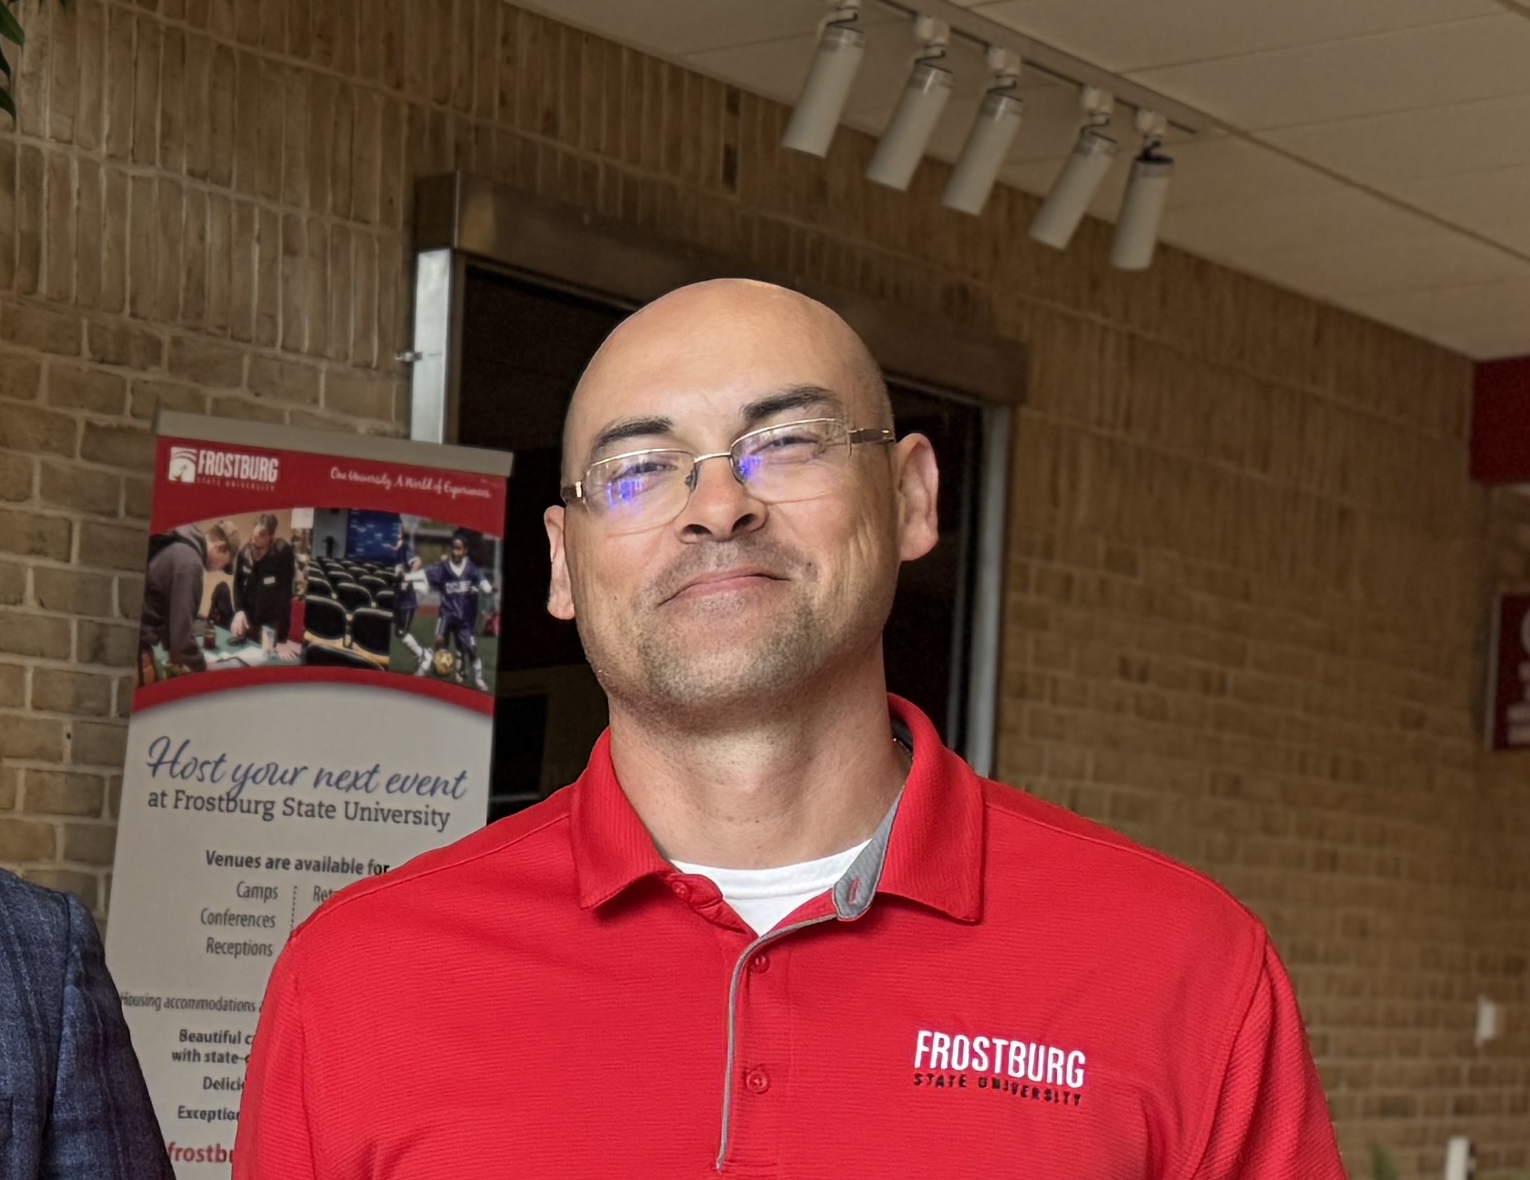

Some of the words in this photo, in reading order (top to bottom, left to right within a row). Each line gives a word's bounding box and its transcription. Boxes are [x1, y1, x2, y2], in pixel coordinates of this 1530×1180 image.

[197, 450, 279, 483] FROSTBURG
[146, 735, 228, 784] Host
[230, 761, 308, 800] your
[313, 763, 380, 794] next
[385, 769, 467, 800] event
[147, 788, 167, 809] at
[172, 789, 276, 822] Frostburg
[282, 797, 337, 820] State
[343, 799, 451, 833] University
[205, 850, 261, 869] Venues
[265, 857, 291, 871] are
[294, 855, 364, 875] available
[236, 880, 279, 903] Camps
[200, 907, 276, 928] Conferences
[205, 936, 274, 959] Receptions
[163, 996, 257, 1013] accommodations
[179, 1028, 242, 1044] Beautiful
[171, 1048, 201, 1063] with
[914, 1030, 1086, 1088] FROSTBURG
[913, 1073, 968, 1088] STATE
[977, 1076, 1082, 1106] UNIVERSITY
